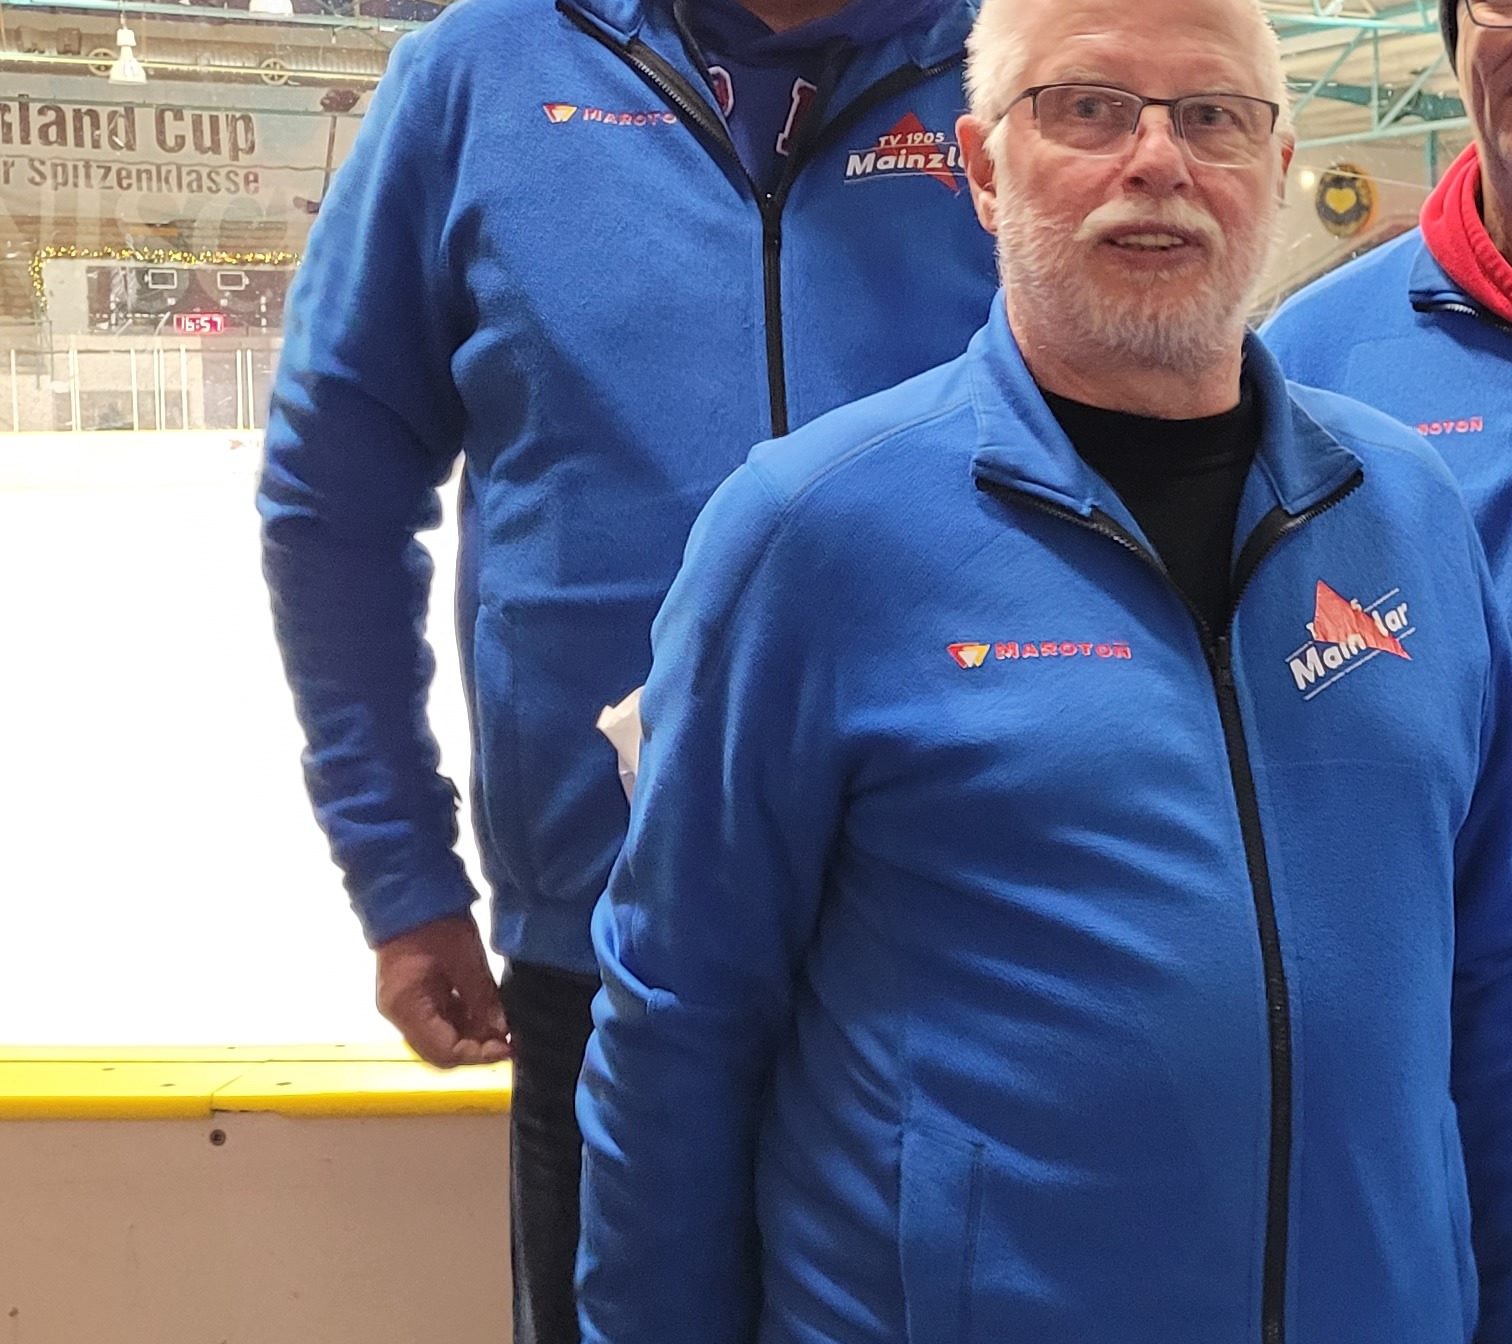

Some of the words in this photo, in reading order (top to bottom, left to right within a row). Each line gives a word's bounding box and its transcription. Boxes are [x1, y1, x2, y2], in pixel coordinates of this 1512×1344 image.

[155, 106, 257, 161] Cup
[877, 133, 903, 148] TV
[906, 132, 945, 145] 1905
[26, 158, 261, 195] Spitzenklasse
[180, 317, 223, 332] 16:57
[994, 642, 1132, 660] MAROTON
